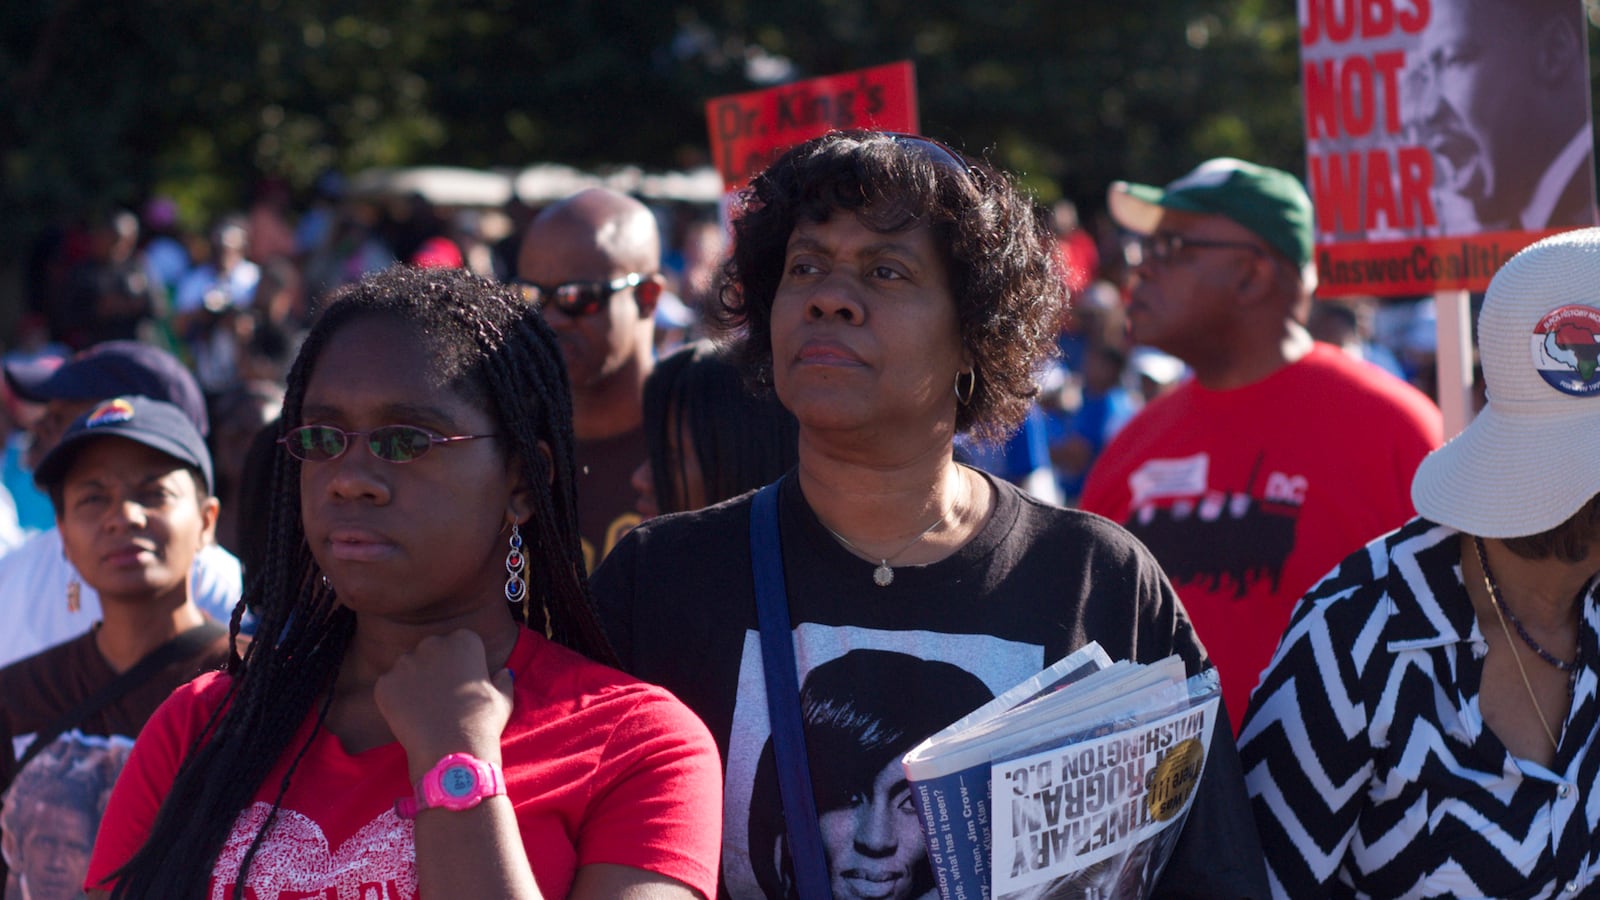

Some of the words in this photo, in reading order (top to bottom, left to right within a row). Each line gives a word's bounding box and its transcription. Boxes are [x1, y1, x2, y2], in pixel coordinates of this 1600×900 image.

[718, 102, 768, 140] Dr.
[776, 73, 884, 130] King's
[1306, 51, 1405, 141] NOT
[1309, 147, 1437, 234] WAR
[1062, 710, 1204, 782] WASHINGTON
[1005, 760, 1052, 795] D.C.
[918, 785, 936, 835] treatment
[934, 790, 949, 822] been?
[941, 823, 950, 832] it
[945, 833, 955, 853] has
[967, 820, 977, 842] Jim
[1010, 790, 1156, 878] TINERARY
[930, 838, 939, 851] its
[932, 853, 943, 863] of
[972, 845, 983, 875] Then,
[948, 855, 960, 880] what
